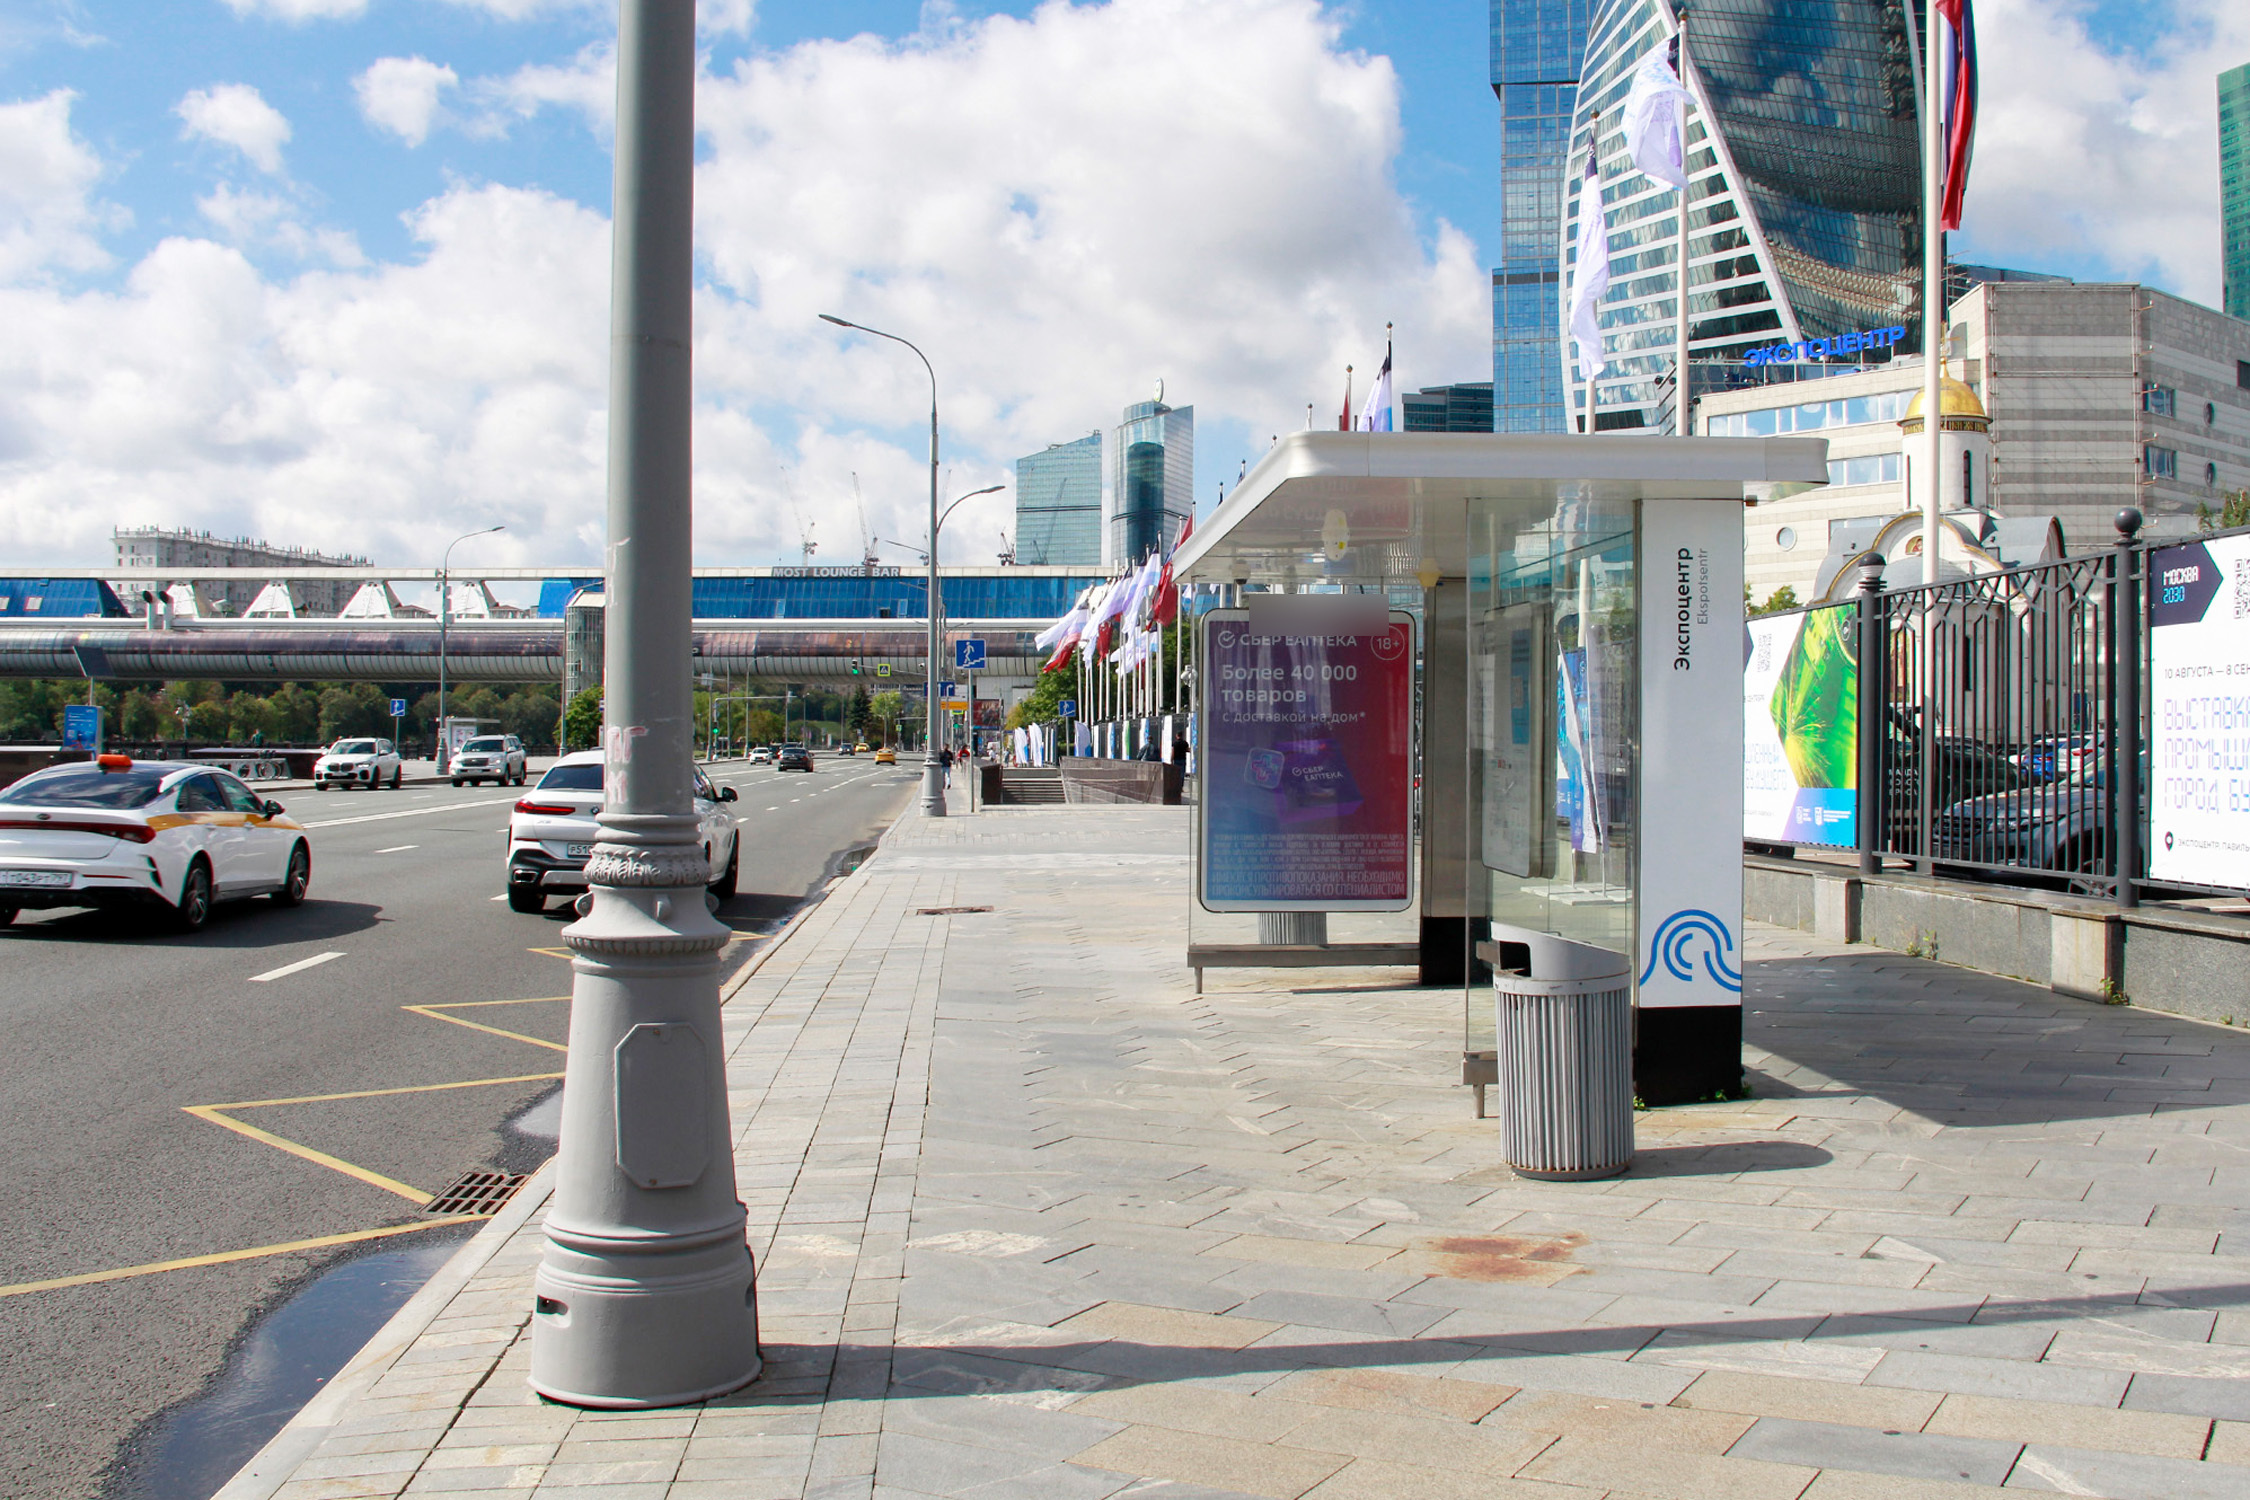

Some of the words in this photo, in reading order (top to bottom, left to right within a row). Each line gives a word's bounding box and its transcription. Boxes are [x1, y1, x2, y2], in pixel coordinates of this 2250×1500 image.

[1743, 325, 1905, 368] ЭКСПОЦЕНТР
[773, 567, 808, 577] MOST
[813, 567, 866, 577] LOUNGE
[872, 567, 899, 577] BAR
[2163, 566, 2200, 585] МОСКВА
[1697, 548, 1710, 625] Ekspotsentr
[2163, 586, 2185, 604] 2030
[1674, 547, 1693, 670] Экспоцентр
[1240, 633, 1281, 647] СБЕР
[1285, 634, 1357, 647] ЕАПТЕКА
[1377, 638, 1400, 650] 18+
[1222, 664, 1284, 680] Более
[1291, 665, 1314, 680] 40
[1322, 665, 1357, 680] 000
[2175, 666, 2213, 678] АВГУСТА
[2226, 664, 2232, 675] 8
[1221, 690, 1306, 705] товаров
[1222, 713, 1230, 721] с
[1234, 711, 1306, 723] доставкой
[1311, 713, 1327, 722] на
[2164, 777, 2219, 814] ГОРОД
